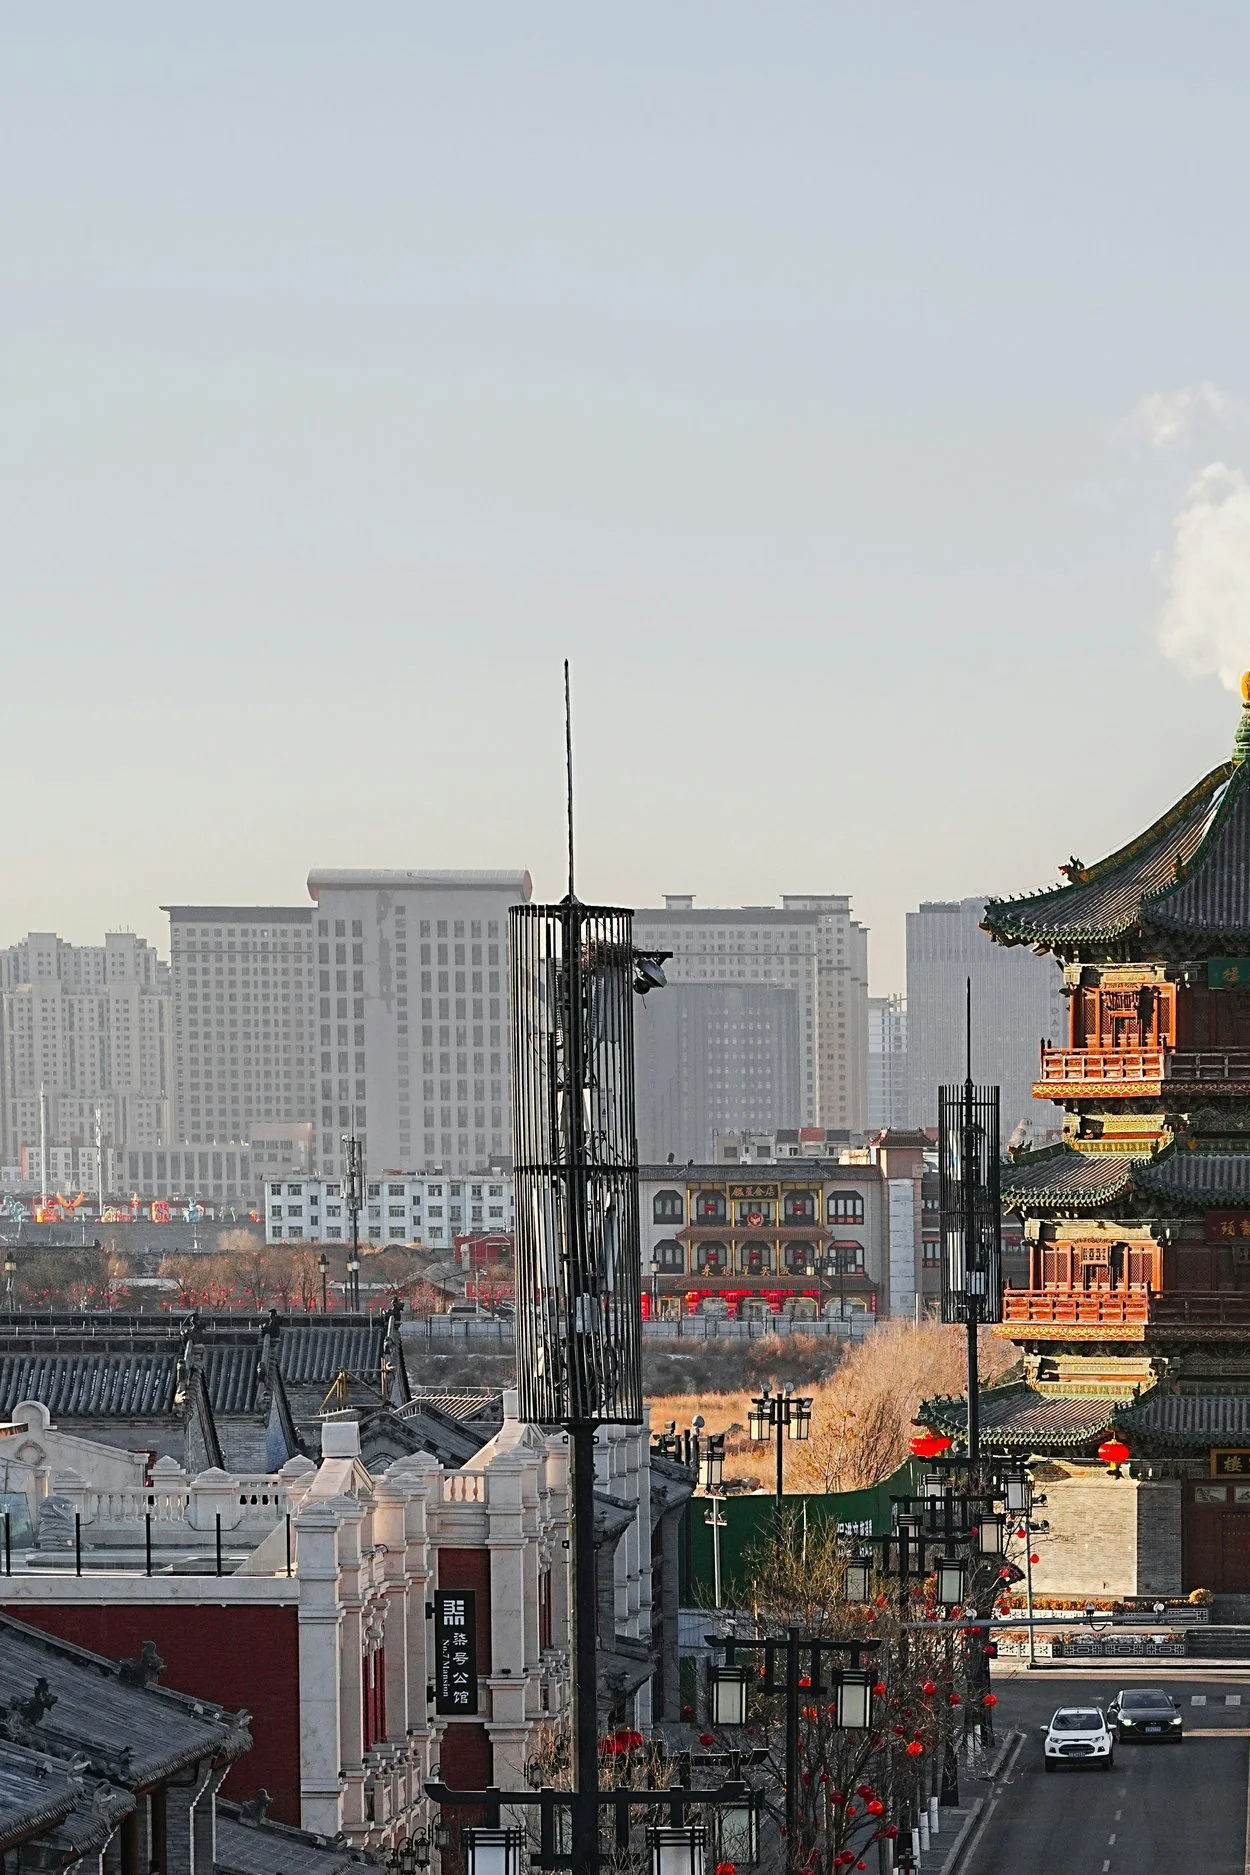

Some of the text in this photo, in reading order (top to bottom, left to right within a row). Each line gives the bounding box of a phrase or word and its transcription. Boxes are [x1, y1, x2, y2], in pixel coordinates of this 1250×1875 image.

[442, 1640, 450, 1697] No.7 Mansion
[453, 1632, 469, 1704] 柒号公馆
